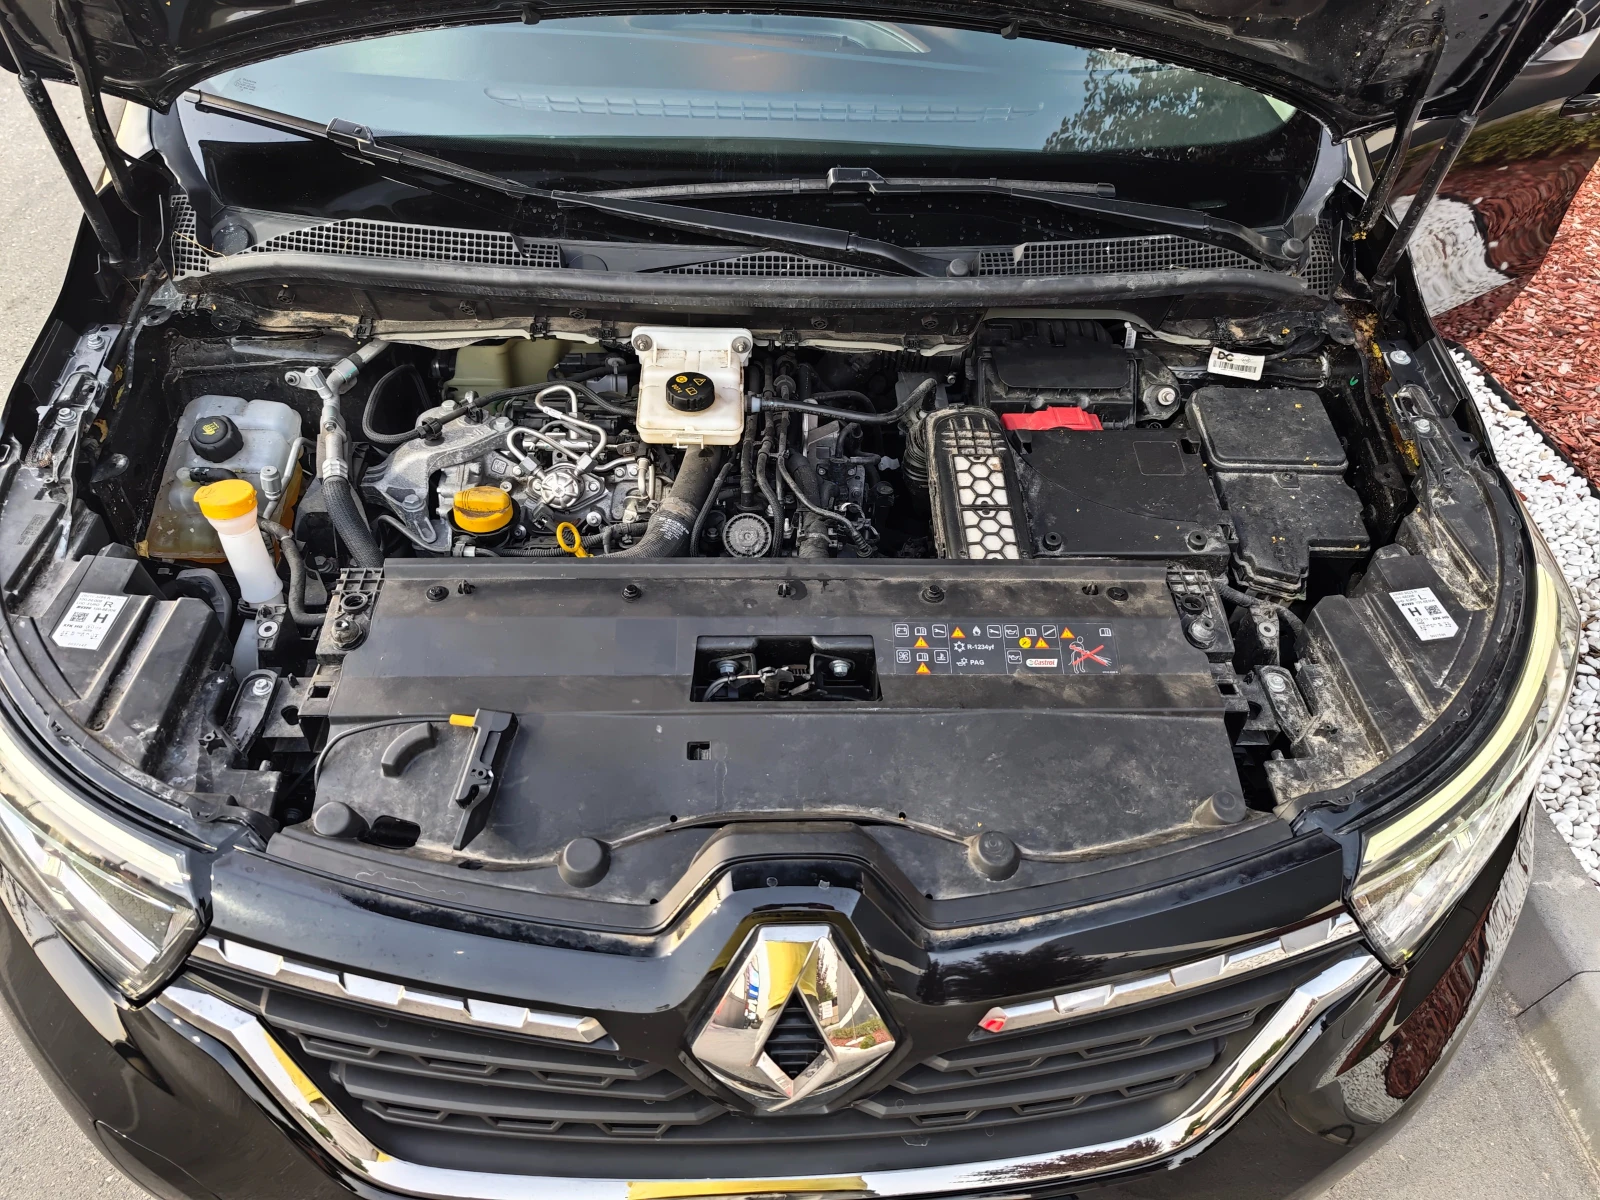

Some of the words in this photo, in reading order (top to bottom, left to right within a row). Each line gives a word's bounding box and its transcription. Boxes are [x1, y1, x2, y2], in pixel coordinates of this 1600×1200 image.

[1217, 351, 1234, 362] DC
[1407, 606, 1422, 617] H
[93, 613, 109, 624] H
[967, 643, 995, 651] R-1234yf
